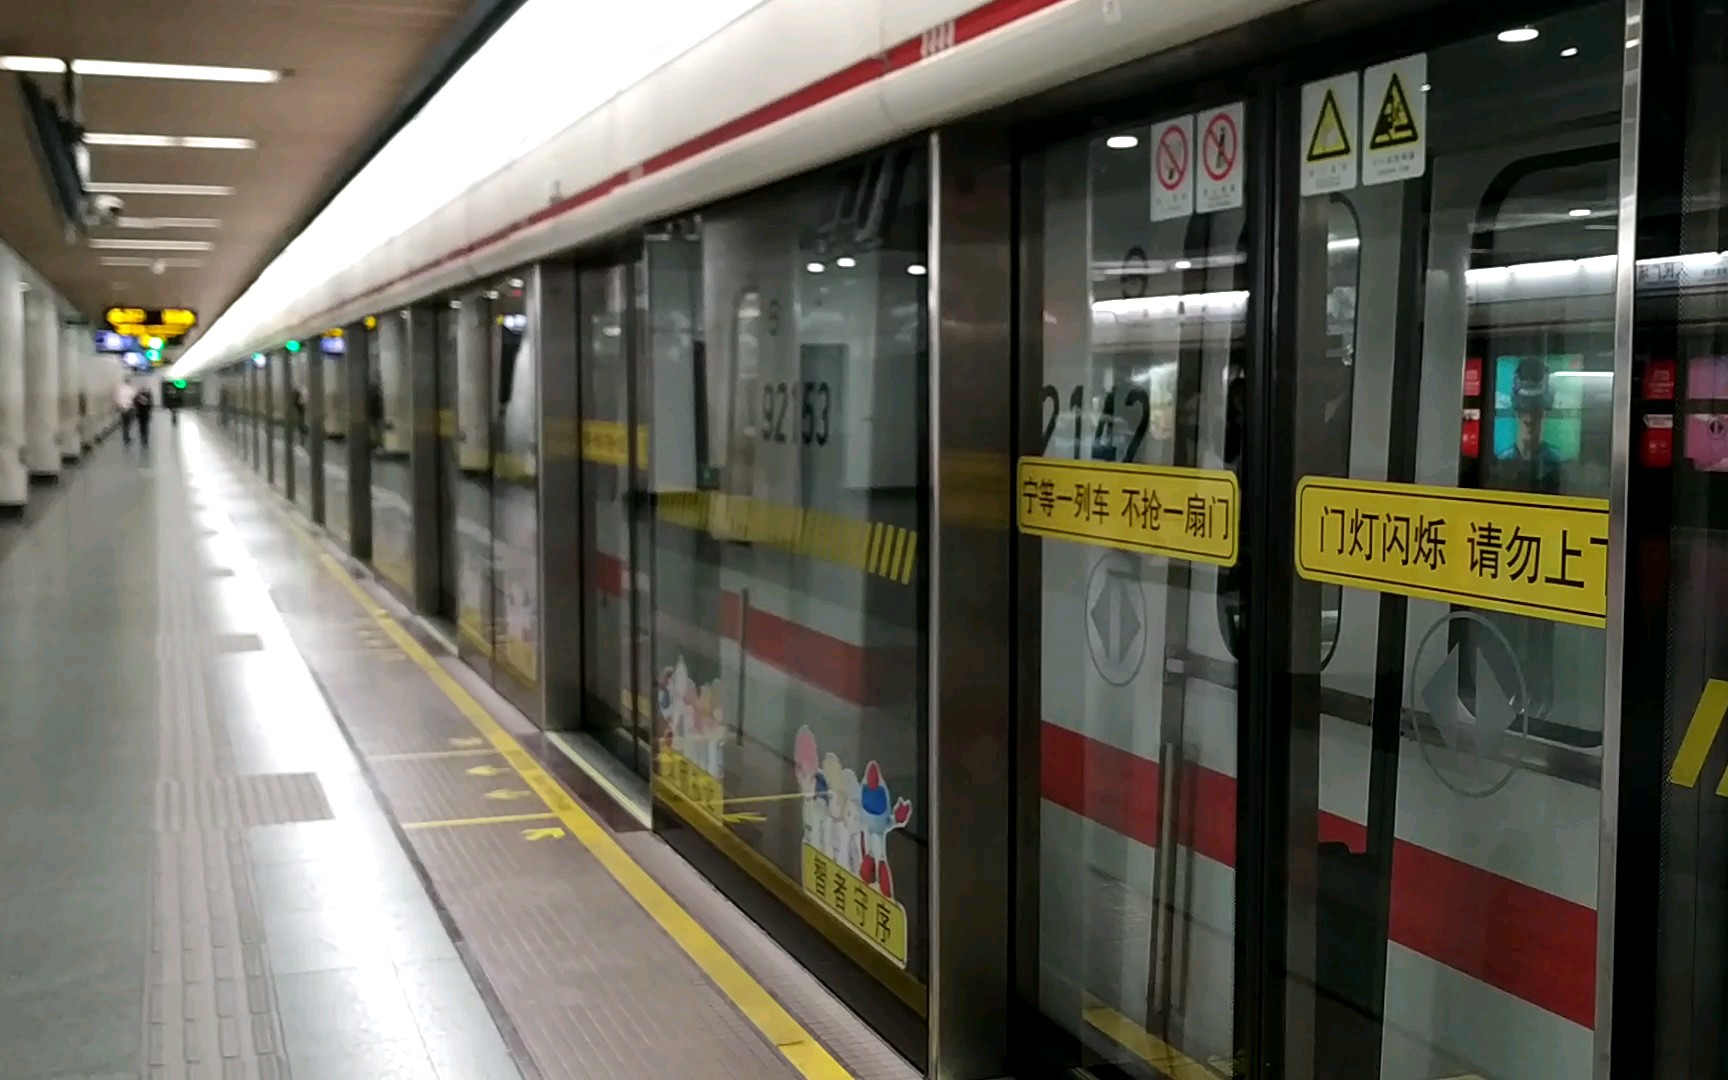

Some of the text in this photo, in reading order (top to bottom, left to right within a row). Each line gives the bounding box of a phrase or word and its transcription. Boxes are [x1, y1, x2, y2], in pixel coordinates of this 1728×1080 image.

[1023, 477, 1230, 540] 宁等一列车 不抢一扇门
[1320, 505, 1447, 571] 门灯闪烁
[813, 854, 892, 943] 智者守序
